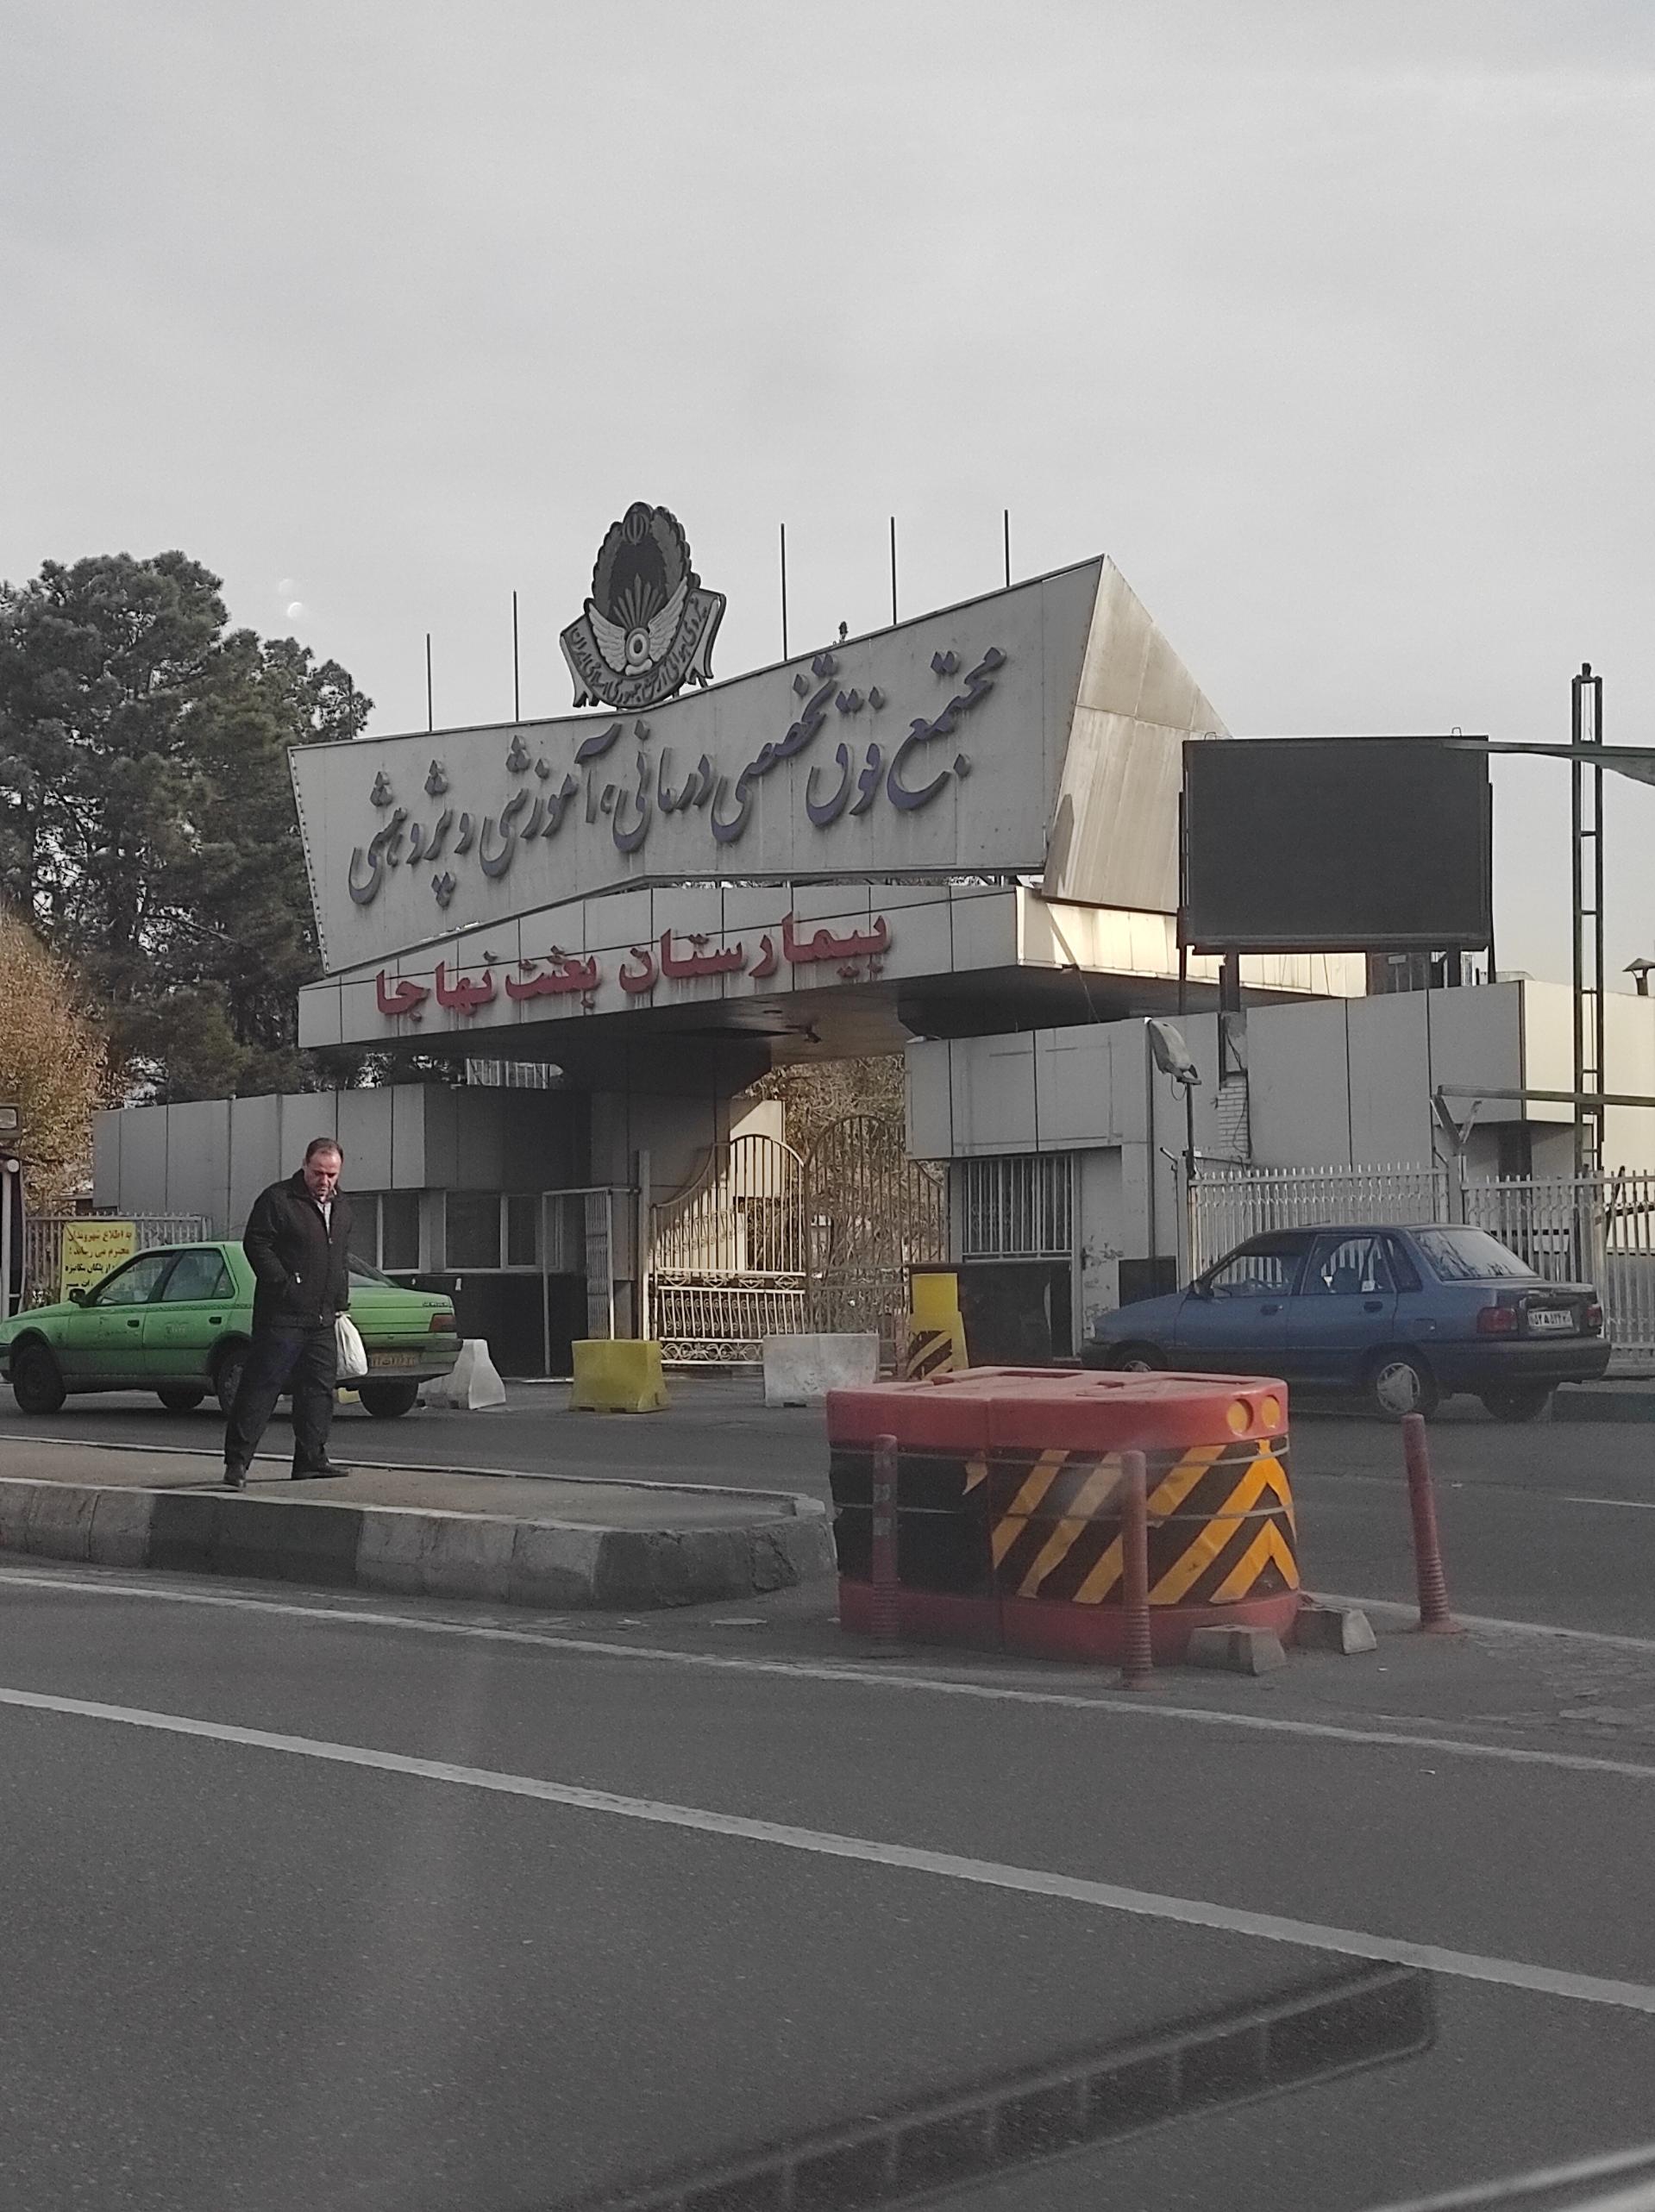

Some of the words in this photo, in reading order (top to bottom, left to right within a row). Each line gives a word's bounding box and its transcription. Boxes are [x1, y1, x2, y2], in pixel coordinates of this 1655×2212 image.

[711, 652, 838, 844] تخصصی
[806, 685, 886, 828] فوق
[887, 646, 1007, 811] مجتمع
[348, 759, 457, 908] پژوهشی
[454, 811, 474, 855] و
[479, 722, 623, 879] آموزشی
[375, 949, 498, 1023] نهاجا
[505, 944, 601, 1009] بعثت
[618, 911, 893, 993] بیمارستان
